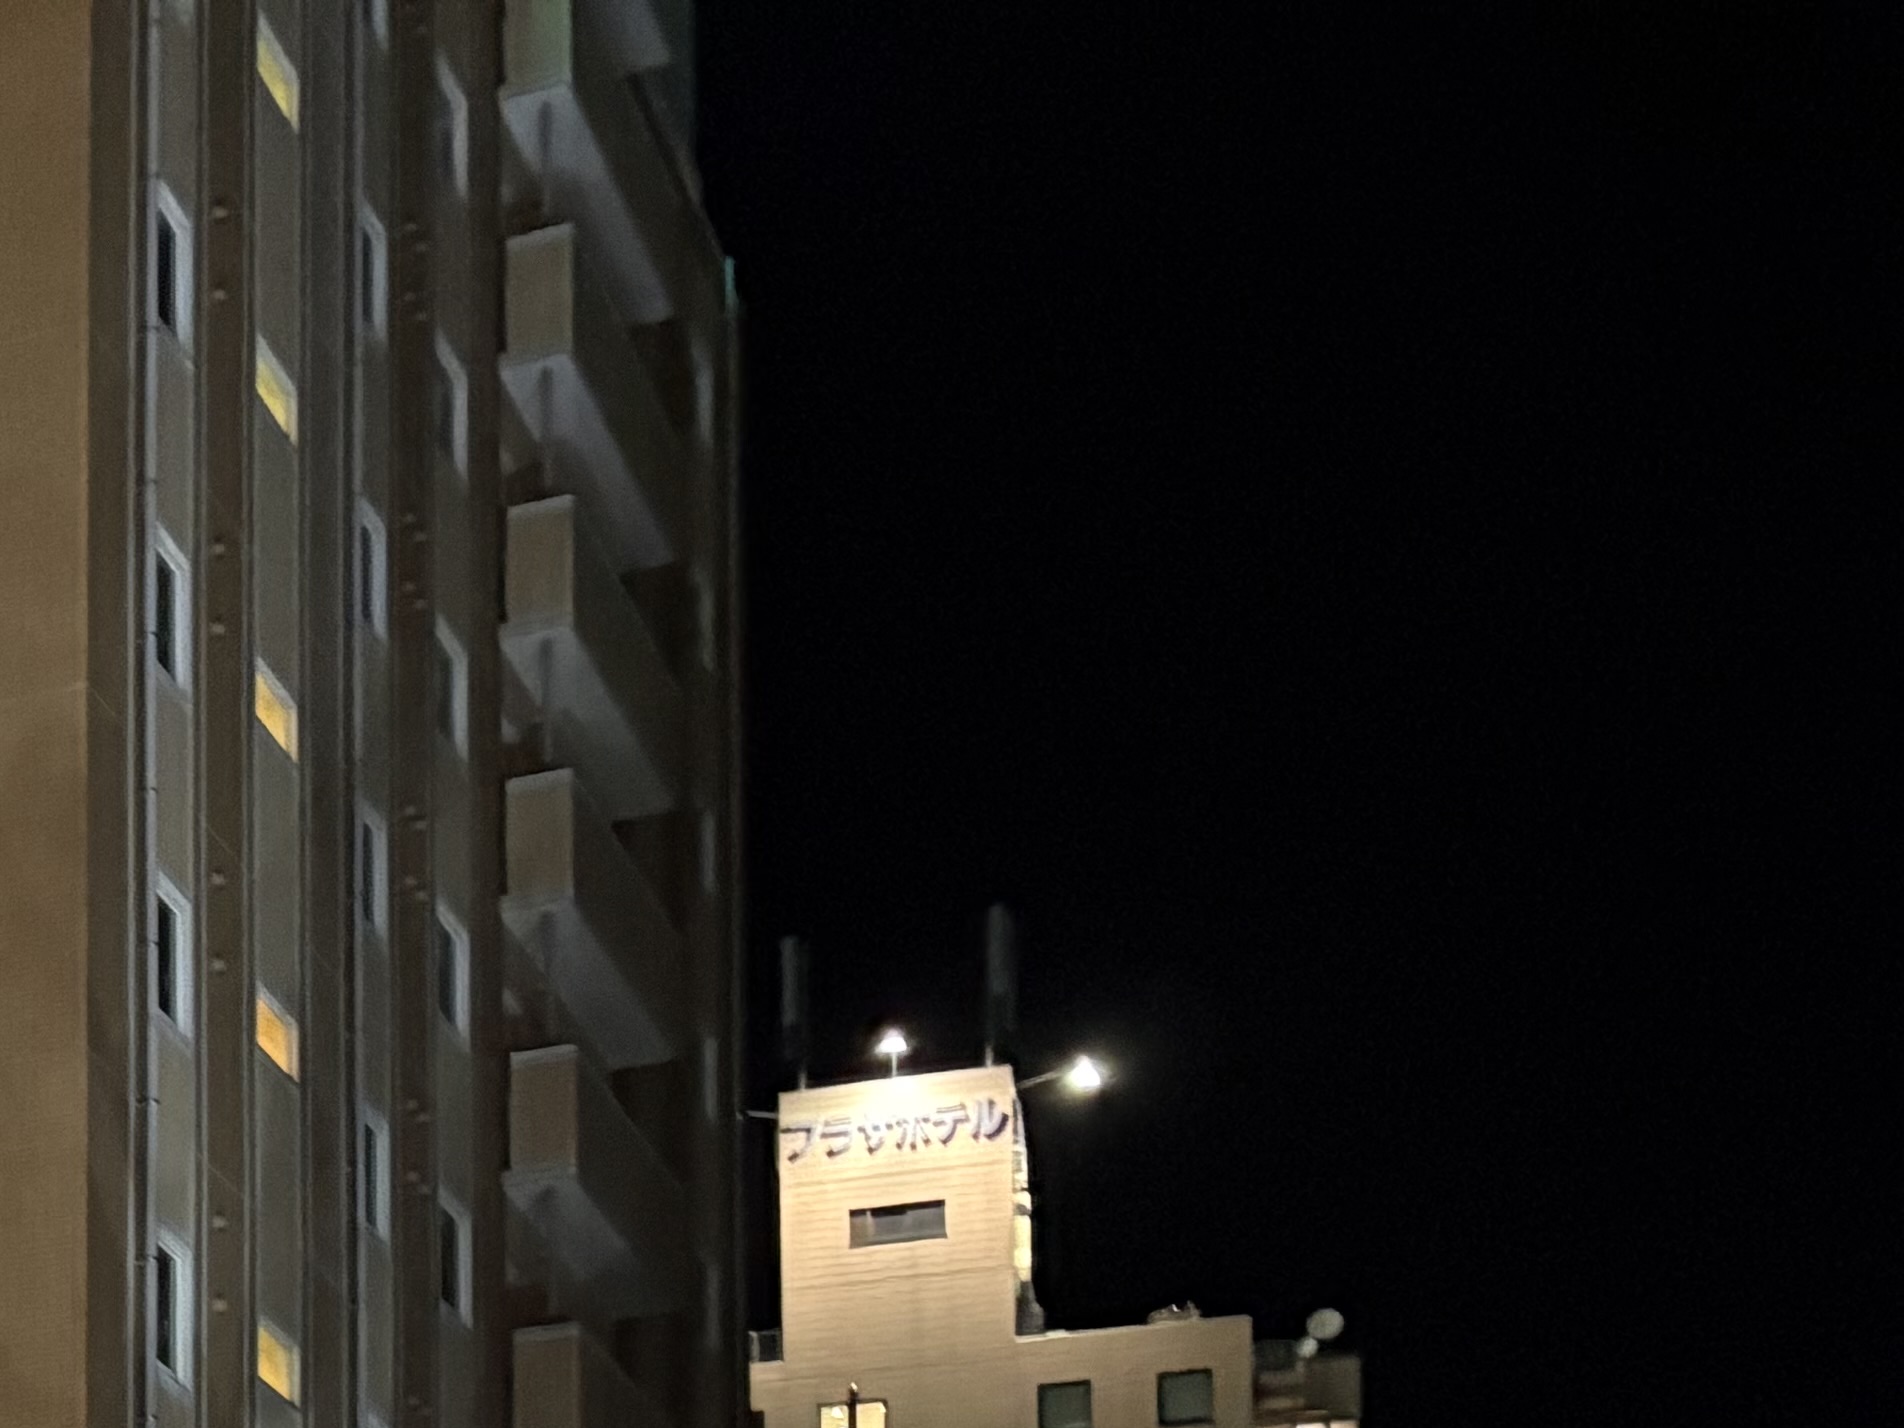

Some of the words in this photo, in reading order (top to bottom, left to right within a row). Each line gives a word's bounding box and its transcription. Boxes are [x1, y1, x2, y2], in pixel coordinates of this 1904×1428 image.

[779, 1098, 1009, 1163] プラザホテル
